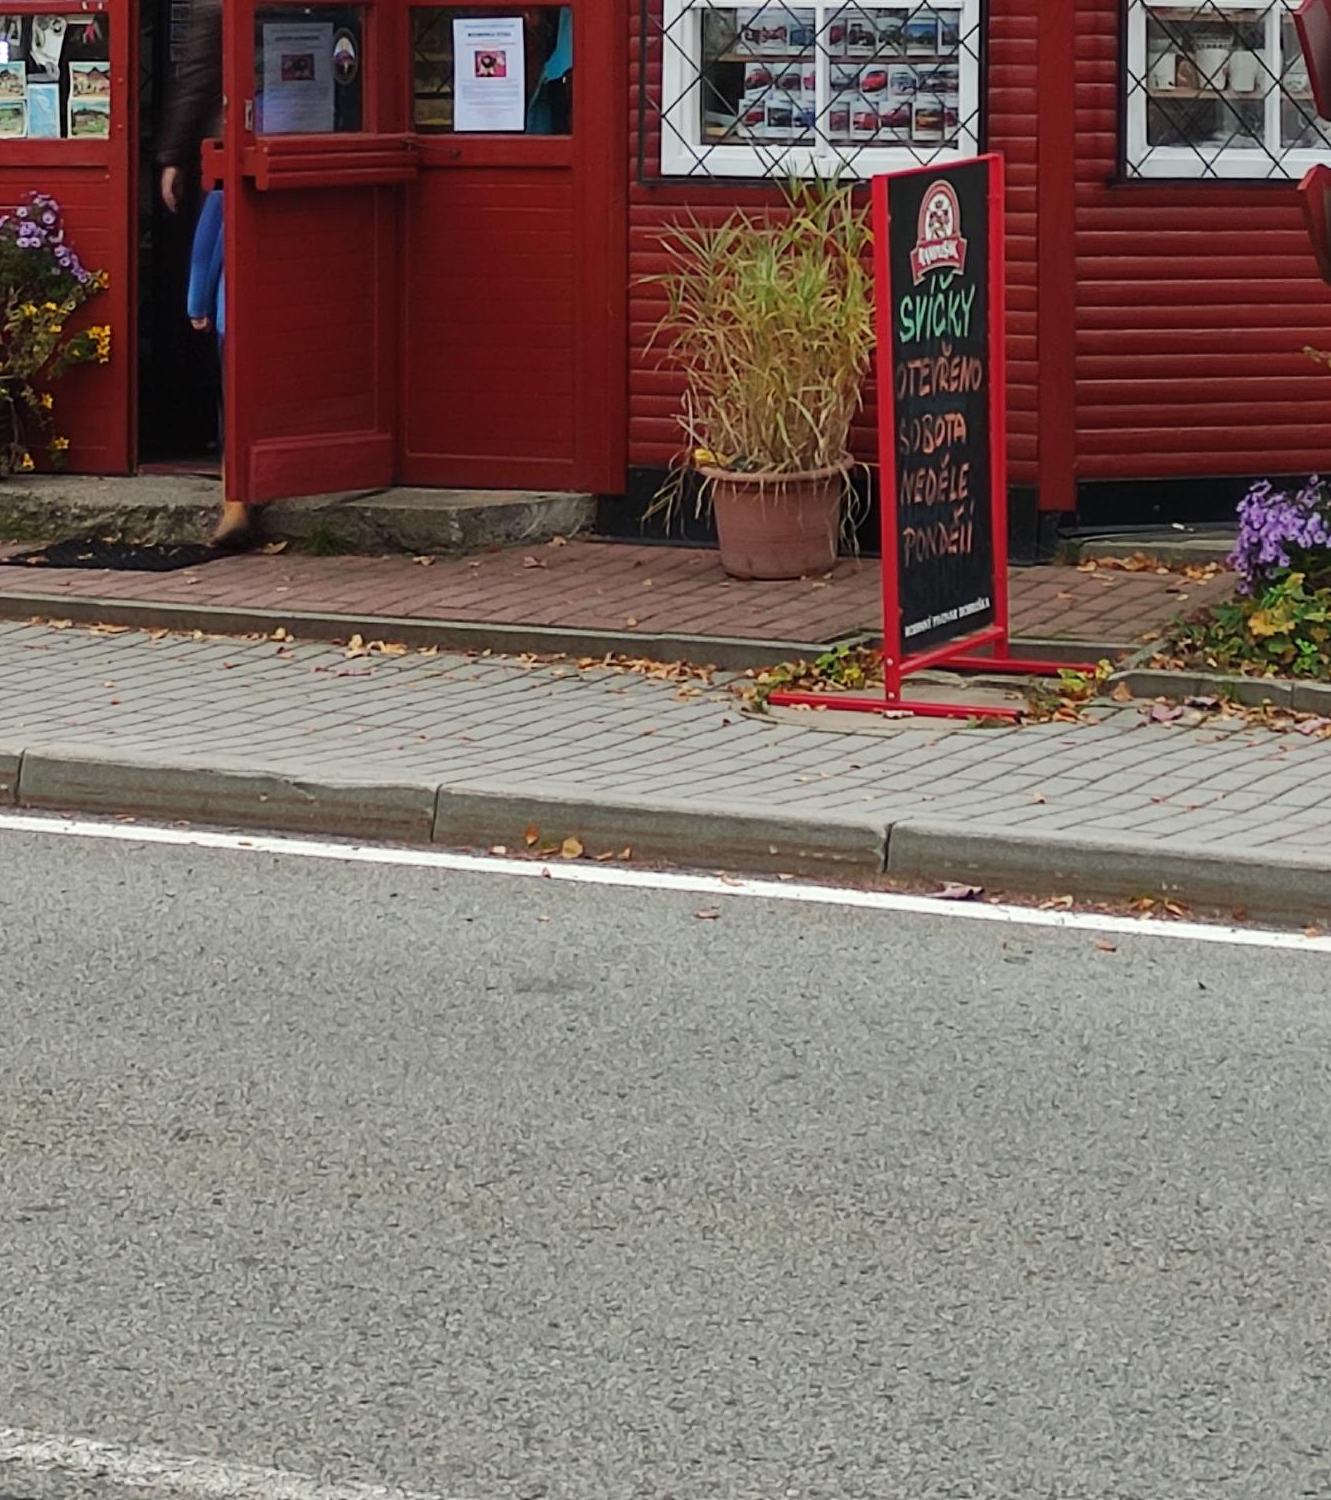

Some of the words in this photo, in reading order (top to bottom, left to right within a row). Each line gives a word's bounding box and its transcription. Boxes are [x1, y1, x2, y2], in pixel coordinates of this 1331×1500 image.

[899, 272, 977, 344] SVÍČKY
[897, 340, 984, 400] OTEVŘENO
[898, 410, 968, 457] SOBOTA
[899, 454, 972, 508] NEDĚLE
[902, 499, 977, 569] PONDĚLÍ
